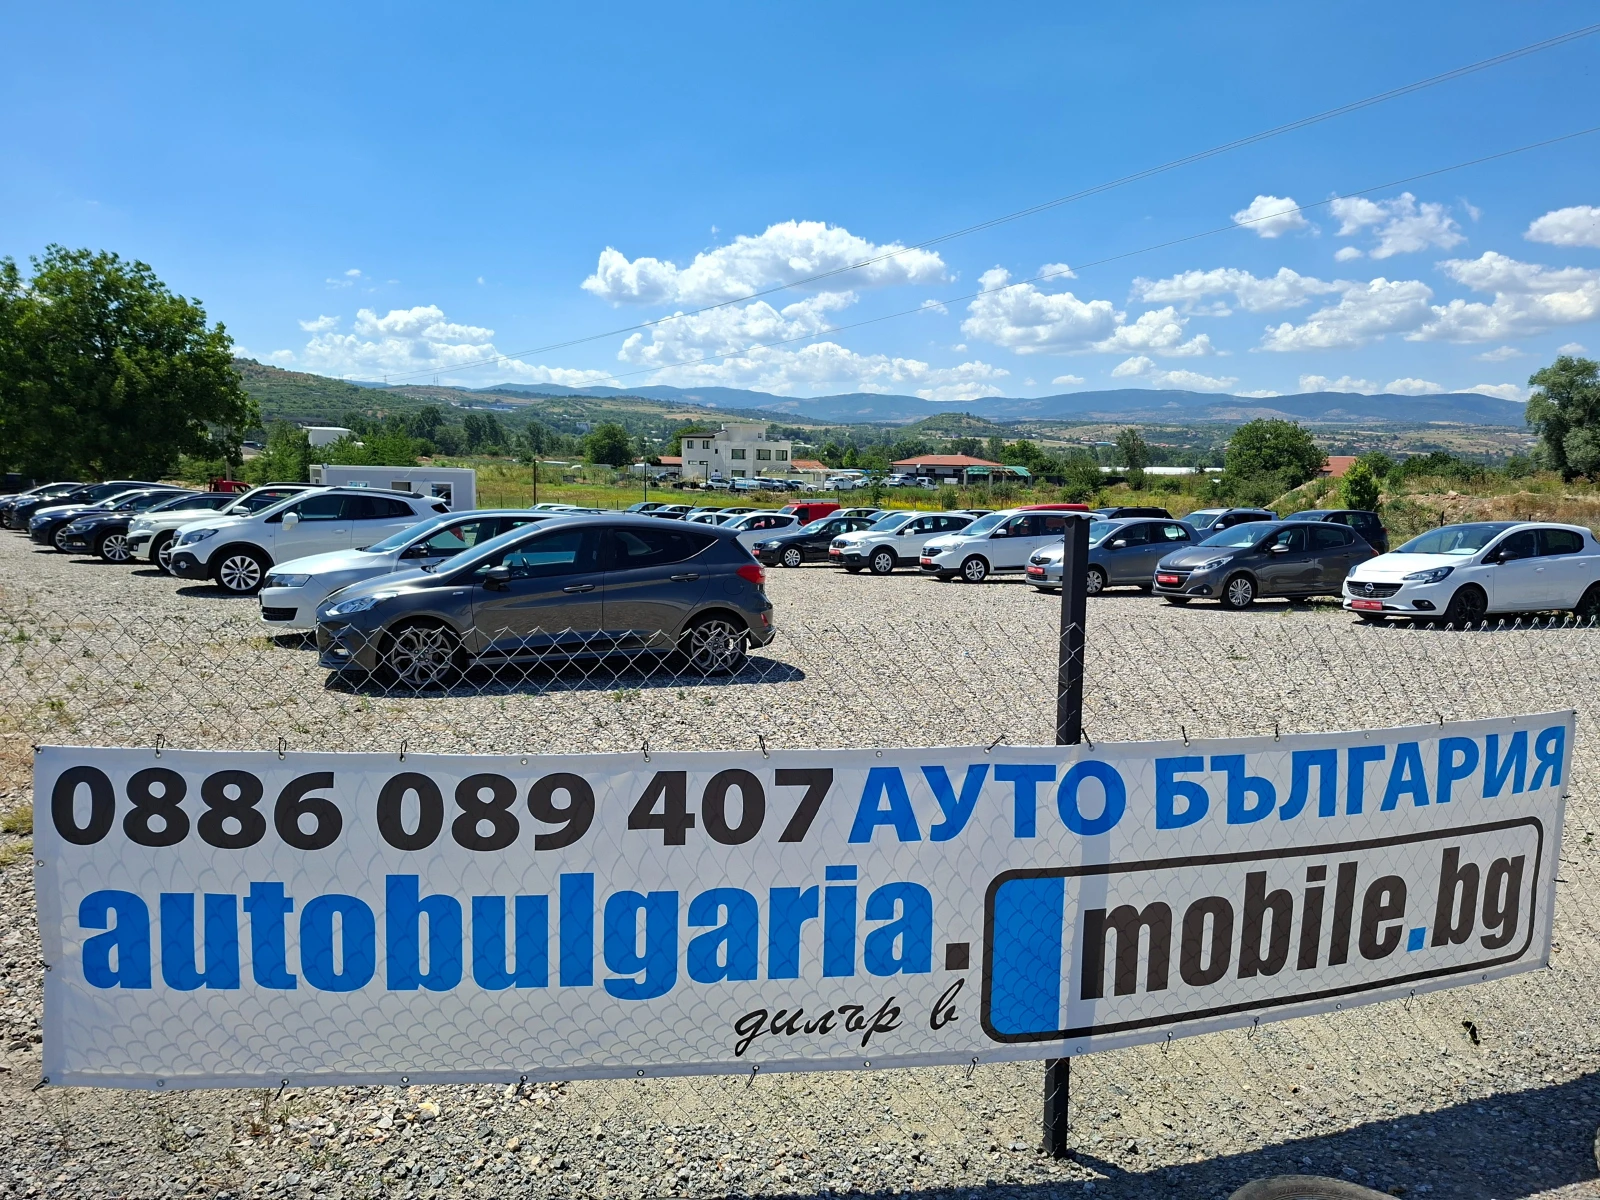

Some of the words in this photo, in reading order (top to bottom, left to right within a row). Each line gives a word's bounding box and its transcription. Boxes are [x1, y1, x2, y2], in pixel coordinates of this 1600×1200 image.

[51, 766, 342, 851] 0886
[377, 771, 595, 852] 089
[628, 768, 834, 846] 407
[848, 760, 1127, 844] АУТО
[1155, 725, 1566, 830] БЪЛГАРИЯ
[1080, 846, 1526, 1001] mobile.bg
[734, 996, 903, 1058] дилър
[929, 978, 965, 1031] в
